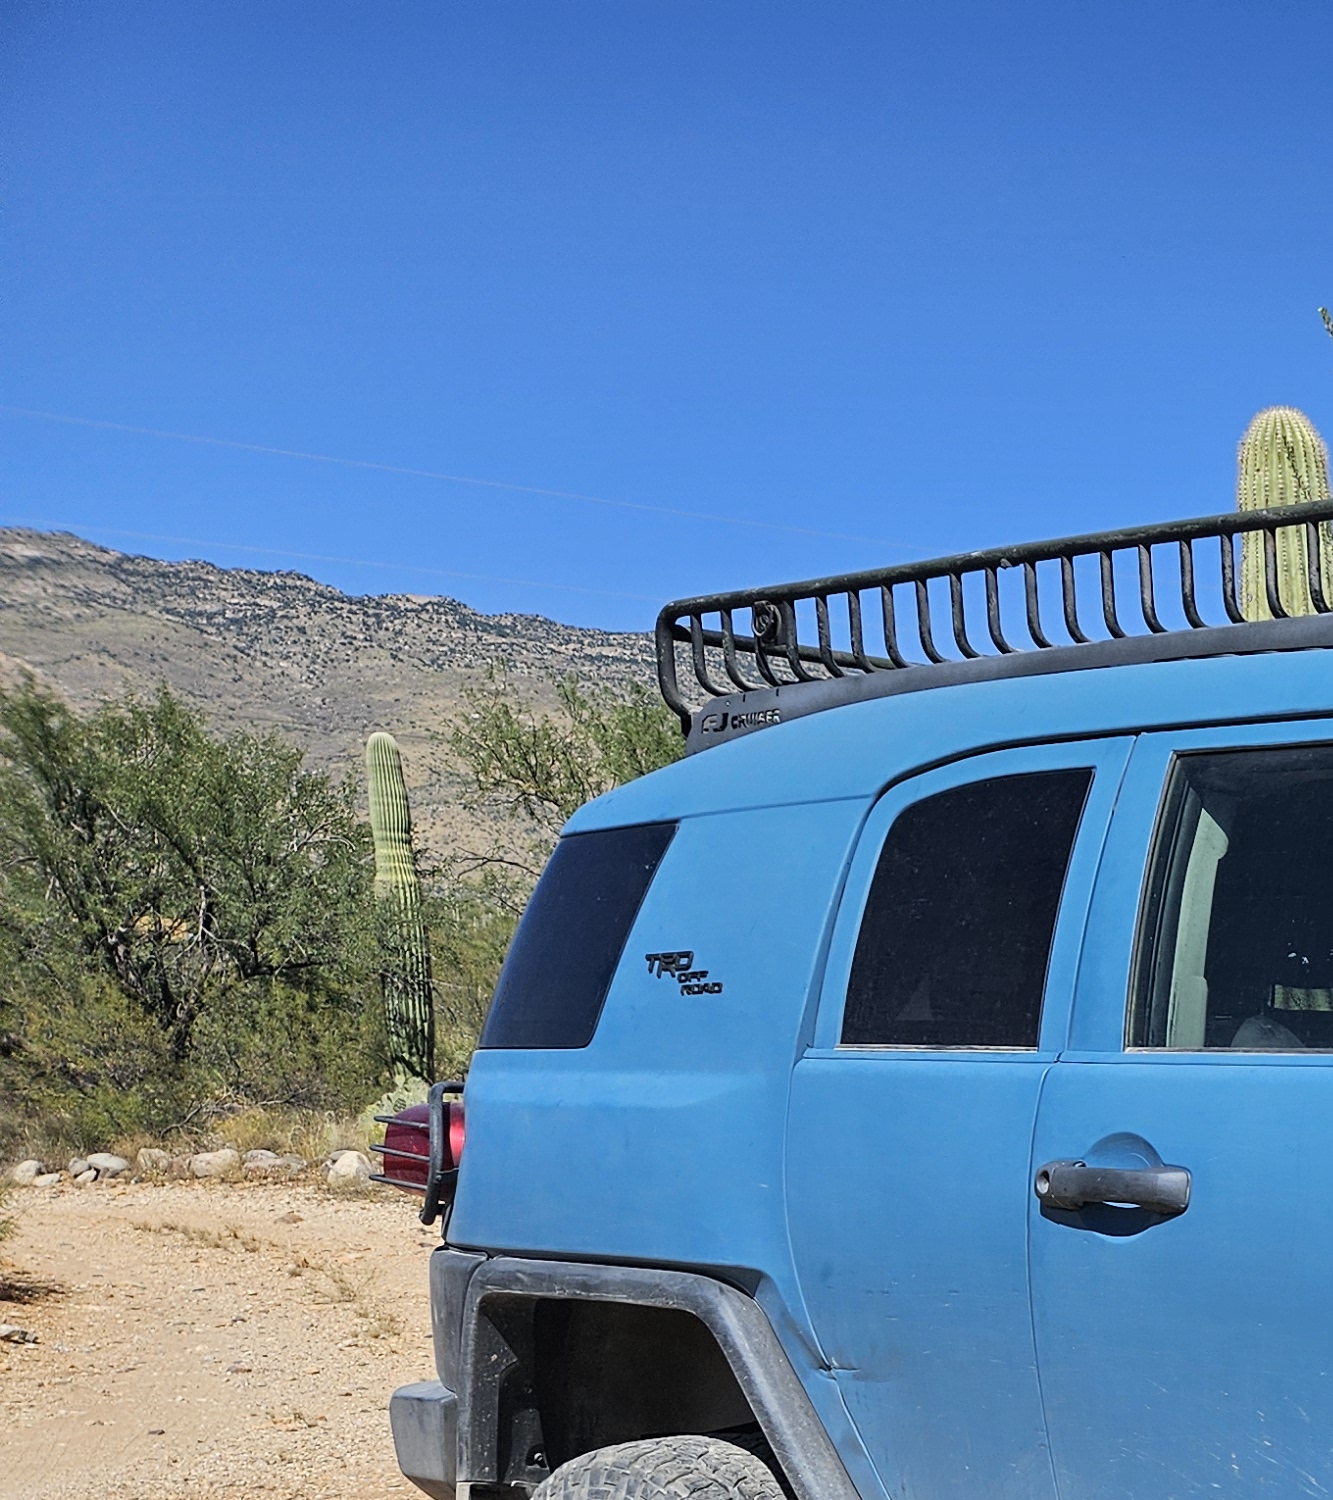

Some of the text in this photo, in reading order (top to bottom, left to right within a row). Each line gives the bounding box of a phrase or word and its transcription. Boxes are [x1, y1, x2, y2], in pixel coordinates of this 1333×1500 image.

[645, 950, 694, 979] TRD
[677, 970, 709, 984] OFF
[680, 982, 723, 996] ROAD
